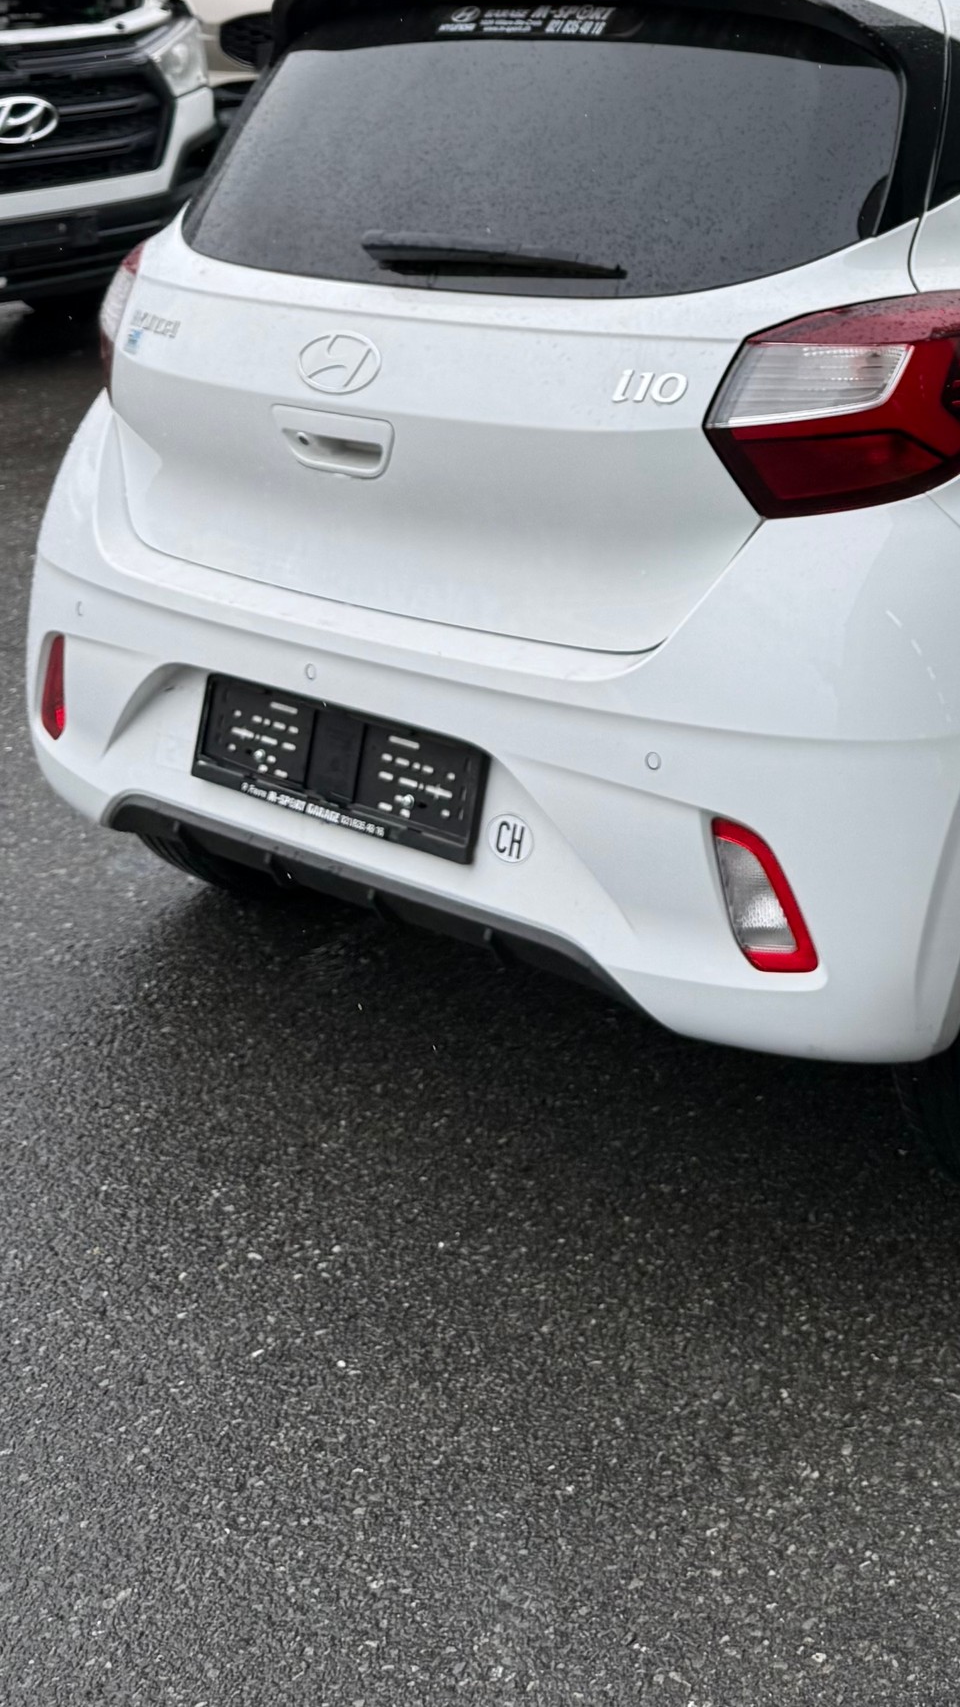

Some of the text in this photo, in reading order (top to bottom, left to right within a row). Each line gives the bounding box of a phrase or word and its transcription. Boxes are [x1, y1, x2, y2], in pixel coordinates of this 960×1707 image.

[531, 5, 615, 20] M-SPORT
[306, 802, 342, 824] GARAGE
[496, 821, 526, 860] CH
